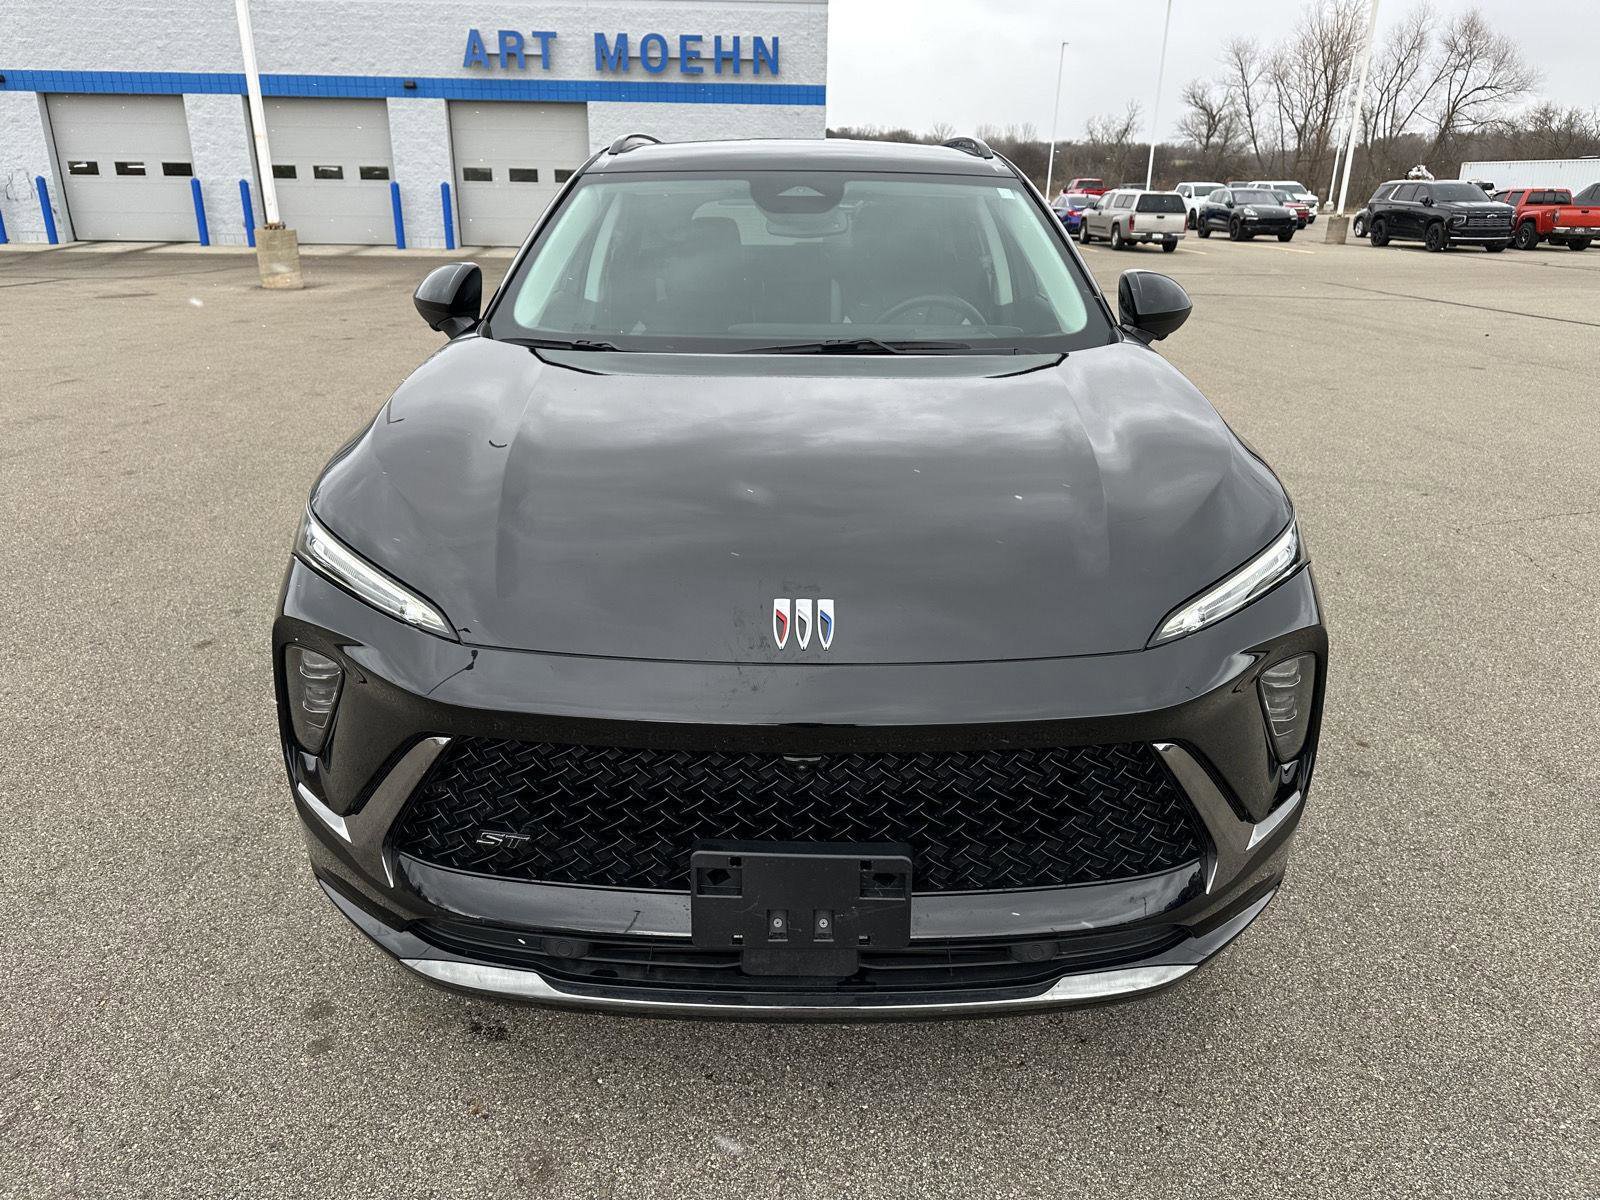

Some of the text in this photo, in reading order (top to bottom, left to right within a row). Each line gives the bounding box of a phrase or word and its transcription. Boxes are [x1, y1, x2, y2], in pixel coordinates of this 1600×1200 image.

[463, 29, 779, 75] ART MOEHN
[476, 831, 531, 849] ST
